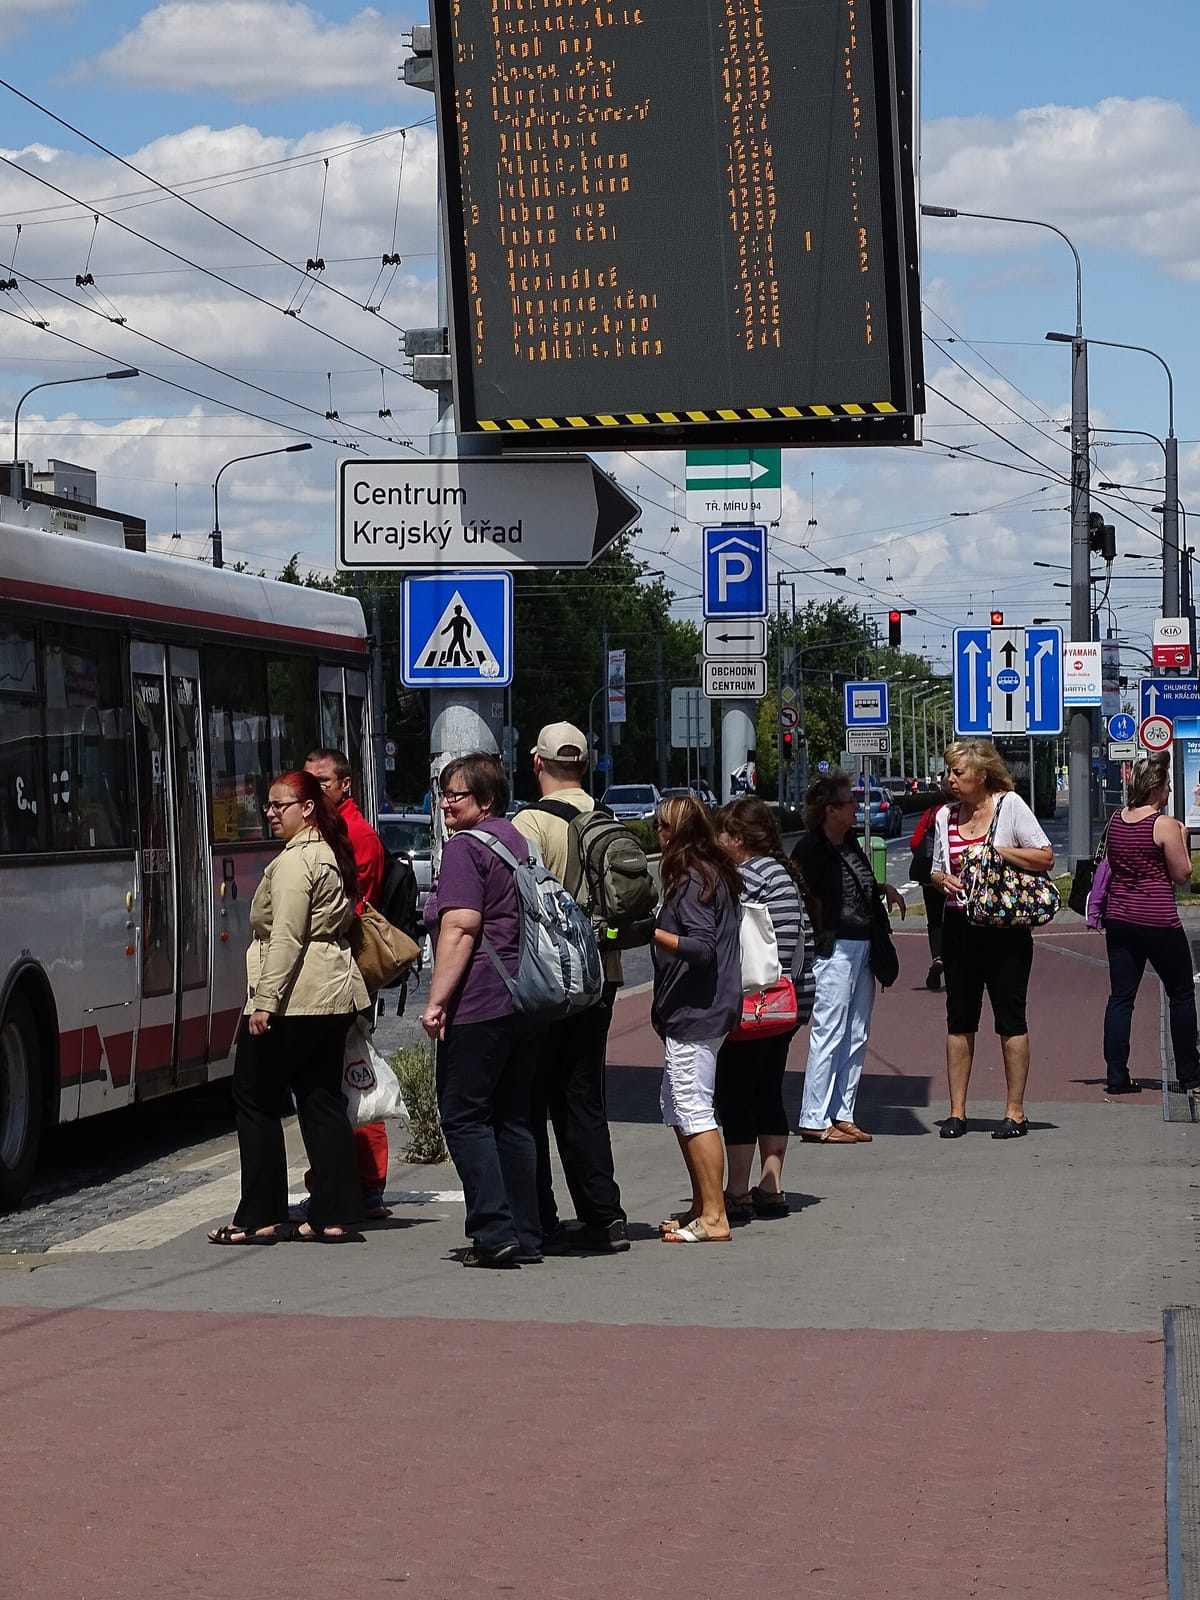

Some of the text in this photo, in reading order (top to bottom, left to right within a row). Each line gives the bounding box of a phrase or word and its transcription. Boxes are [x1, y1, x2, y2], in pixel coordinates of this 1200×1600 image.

[353, 481, 468, 506] Centrum
[705, 500, 762, 511] TŘ. MÍRU 94
[353, 519, 523, 550] Krajský úřad
[718, 552, 753, 602] P
[1163, 627, 1178, 635] KIA
[1068, 648, 1098, 657] YAMAHA
[711, 663, 757, 677] OBCHODNÍ
[712, 680, 756, 692] CENTRUM
[880, 739, 887, 750] 3
